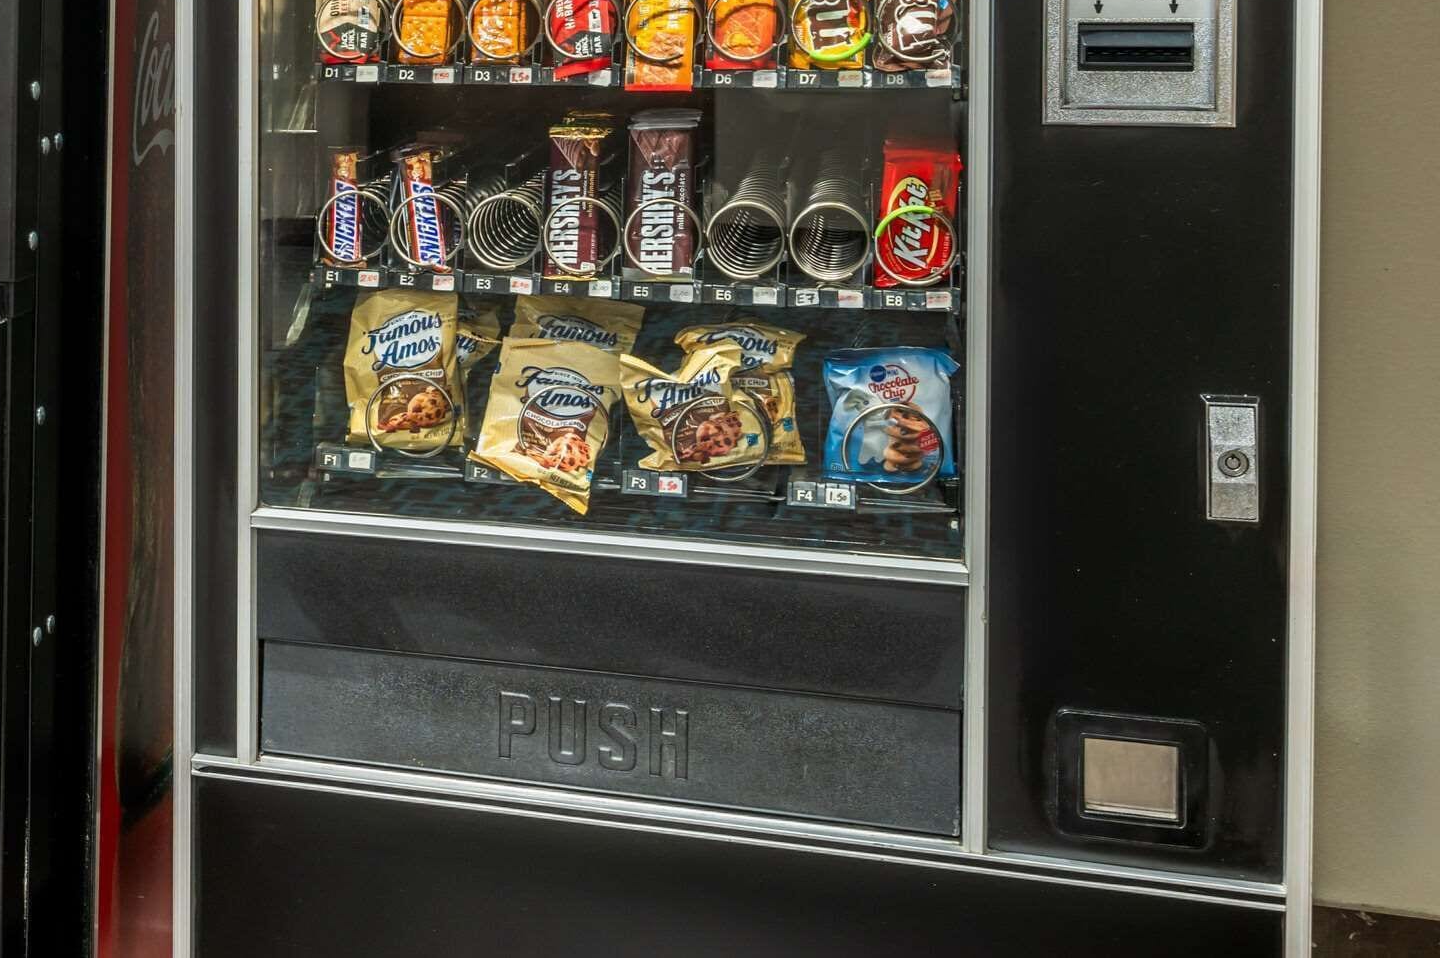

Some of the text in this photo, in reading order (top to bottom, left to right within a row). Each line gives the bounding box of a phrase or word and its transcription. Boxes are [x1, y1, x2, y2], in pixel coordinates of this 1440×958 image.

[360, 32, 368, 49] BAR
[594, 35, 602, 54] BAR
[325, 69, 339, 78] D1
[399, 69, 414, 80] D2
[475, 71, 490, 81] D3
[715, 73, 732, 84] D6
[799, 75, 816, 85] D7
[887, 75, 904, 85] D8
[334, 182, 357, 260] SNICKERS
[549, 169, 581, 265] HERSHEY'S
[412, 183, 441, 264] SNICKERS
[326, 271, 339, 281] E1
[400, 275, 414, 285] E2
[477, 279, 491, 289] E3
[554, 283, 569, 292] E4
[634, 287, 648, 296] E5
[716, 290, 731, 300] E6
[886, 296, 903, 306] E8
[362, 312, 442, 354] Famous
[372, 336, 441, 371] Amos
[425, 370, 443, 378] CHIP
[515, 366, 604, 394] Famous
[868, 376, 920, 393] Chocolate
[521, 388, 596, 409] Amos
[883, 388, 906, 400] Chip
[526, 411, 567, 427] CHOCOLATE
[324, 455, 337, 465] F1
[473, 467, 488, 477] F2
[631, 478, 647, 489] F3
[796, 490, 813, 501] F4
[829, 492, 847, 502] 1.50
[499, 692, 689, 780] PUSH
